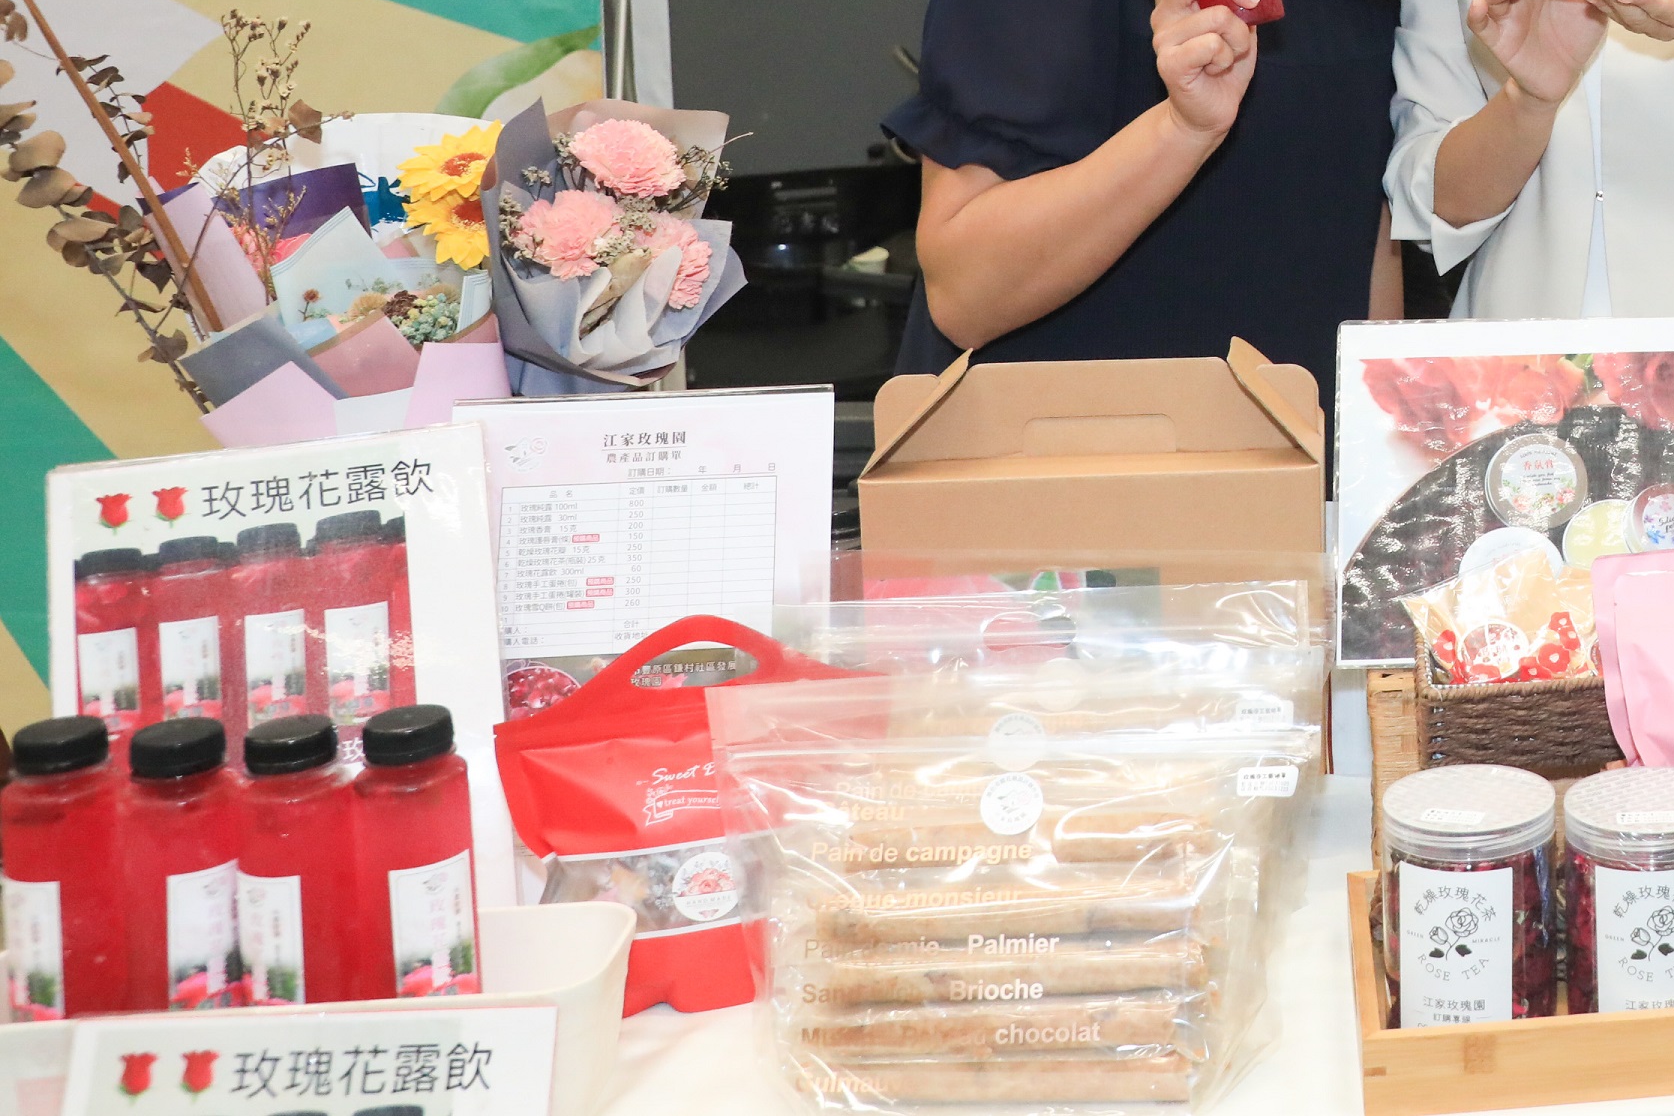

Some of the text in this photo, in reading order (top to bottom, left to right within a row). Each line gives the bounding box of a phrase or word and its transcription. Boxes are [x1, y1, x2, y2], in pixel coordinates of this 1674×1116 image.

[603, 431, 687, 447] 江家玫瑰園
[606, 450, 682, 463] 農產品訂購單
[732, 464, 742, 473] 月
[768, 463, 776, 471] 日
[201, 458, 435, 520] 玫瑰花露飲
[626, 576, 641, 584] 250
[625, 599, 640, 607] 260
[652, 764, 700, 785] Sweet
[664, 795, 720, 807] treat yoursel
[811, 842, 1033, 865] Pain de campagne
[1414, 885, 1497, 922] 乾燥玫瑰花茶
[968, 933, 1060, 955] Palmier
[1418, 953, 1490, 981] ROSE TEA
[1618, 956, 1654, 983] ROSE
[950, 979, 1044, 1001] Brioche
[1423, 995, 1486, 1011] 江家玫瑰園
[1433, 1013, 1471, 1023] 訂購專線
[995, 1021, 1102, 1045] chocolat
[230, 1042, 494, 1100] 玫瑰花露飲
